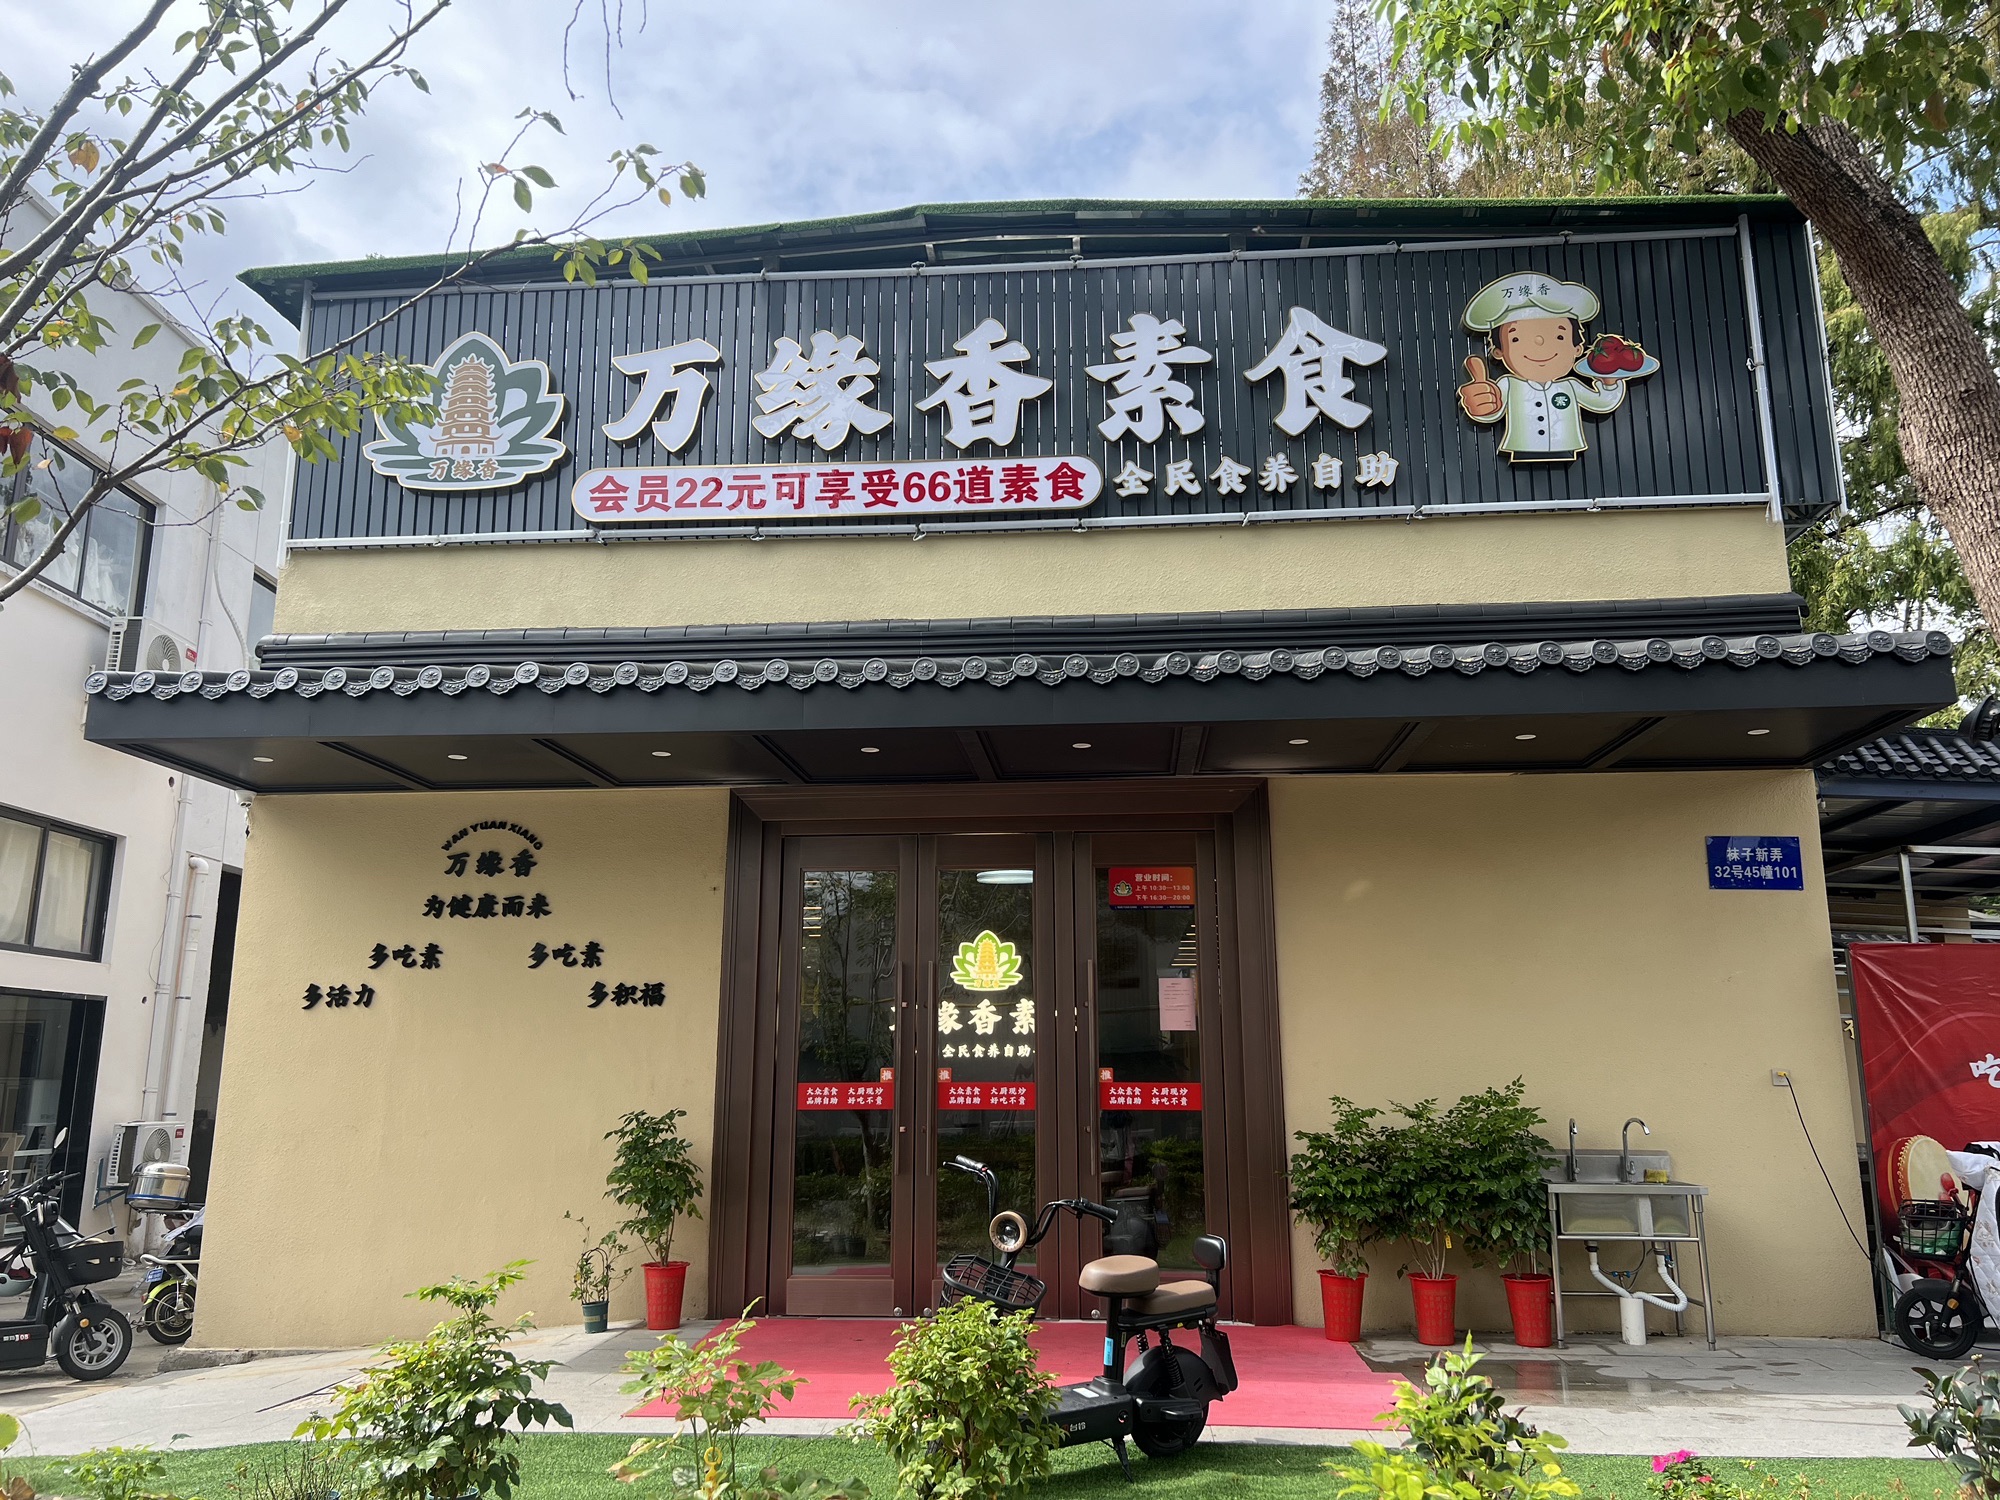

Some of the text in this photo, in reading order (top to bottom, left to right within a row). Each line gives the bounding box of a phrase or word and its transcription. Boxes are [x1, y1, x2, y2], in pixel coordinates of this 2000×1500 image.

[1501, 283, 1551, 298] 万缘香
[602, 307, 1388, 453] 万缘香素食
[428, 458, 500, 480] 万缘香
[1112, 451, 1401, 498] 全民食养自助
[588, 458, 1088, 513] 会员22元可享受66道素食
[441, 828, 469, 851] WAN
[469, 820, 508, 833] YUAN
[1726, 847, 1783, 862] 袜子新弄
[444, 849, 538, 878] 万缘香
[1134, 873, 1173, 882] 营业时间:
[1714, 864, 1798, 880] 32号45幢101
[421, 893, 552, 919] 为健康而来
[368, 942, 444, 970] 多吃素
[528, 941, 604, 969] 多吃素
[301, 983, 375, 1010] 多活力
[587, 981, 665, 1008] 多积福
[942, 1043, 1031, 1058] 全民食养自助
[881, 1070, 893, 1081] 推
[938, 1070, 950, 1081] 推
[1100, 1070, 1112, 1081] 推
[806, 1087, 884, 1096] 大众素食 大厨现炒
[949, 1087, 1027, 1096] 大众素食 大厨现炒
[1109, 1087, 1189, 1096] 大众素食 大厨现炒
[806, 1096, 883, 1106] 品牌自助 好吃不贵
[948, 1096, 1026, 1106] 品牌自助 好吃不贵
[1109, 1097, 1188, 1106] 品牌自助 好吃不贵
